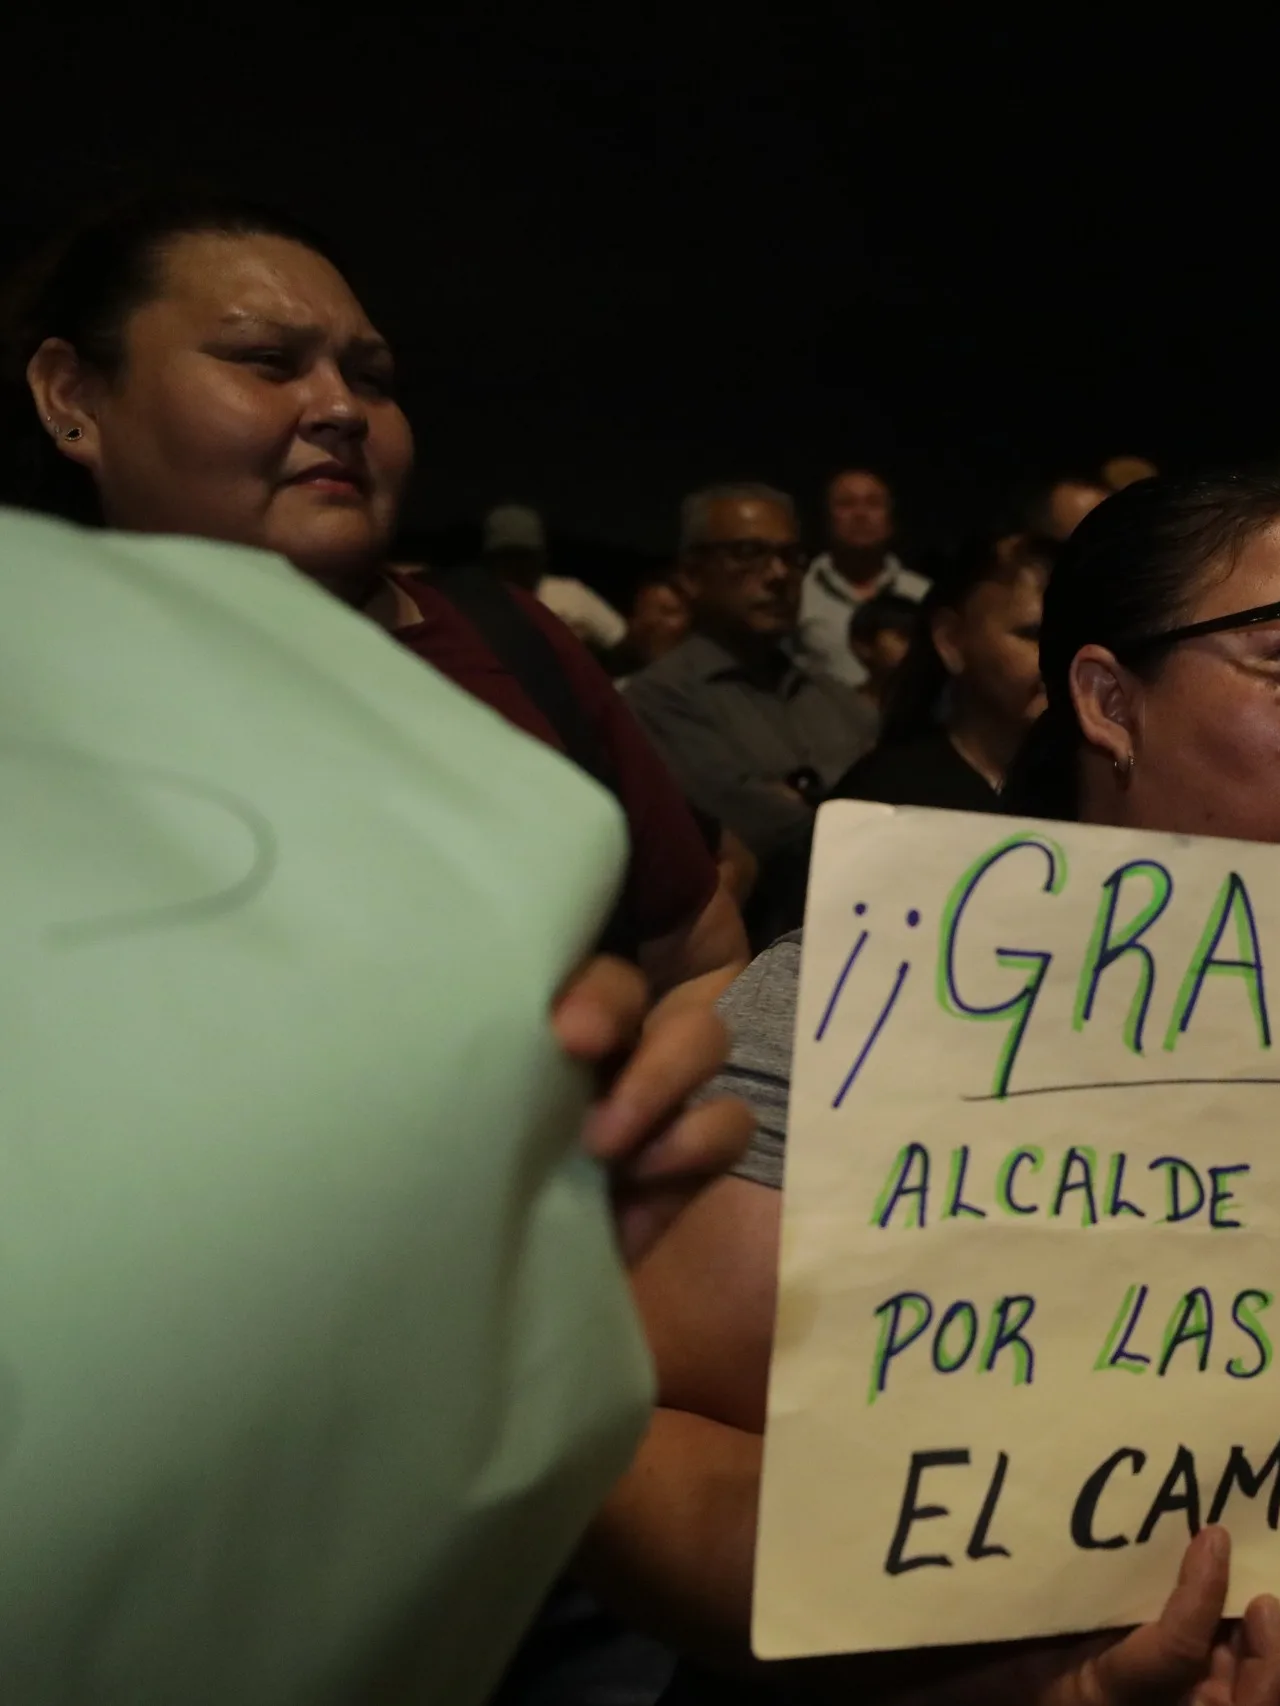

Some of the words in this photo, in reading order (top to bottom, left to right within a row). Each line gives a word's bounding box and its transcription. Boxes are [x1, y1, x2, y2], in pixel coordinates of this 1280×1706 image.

[868, 1141, 1251, 1228] ALCALDE
[868, 1291, 1036, 1405] POR
[1094, 1284, 1274, 1378] LAS
[884, 1448, 1012, 1576] EL
